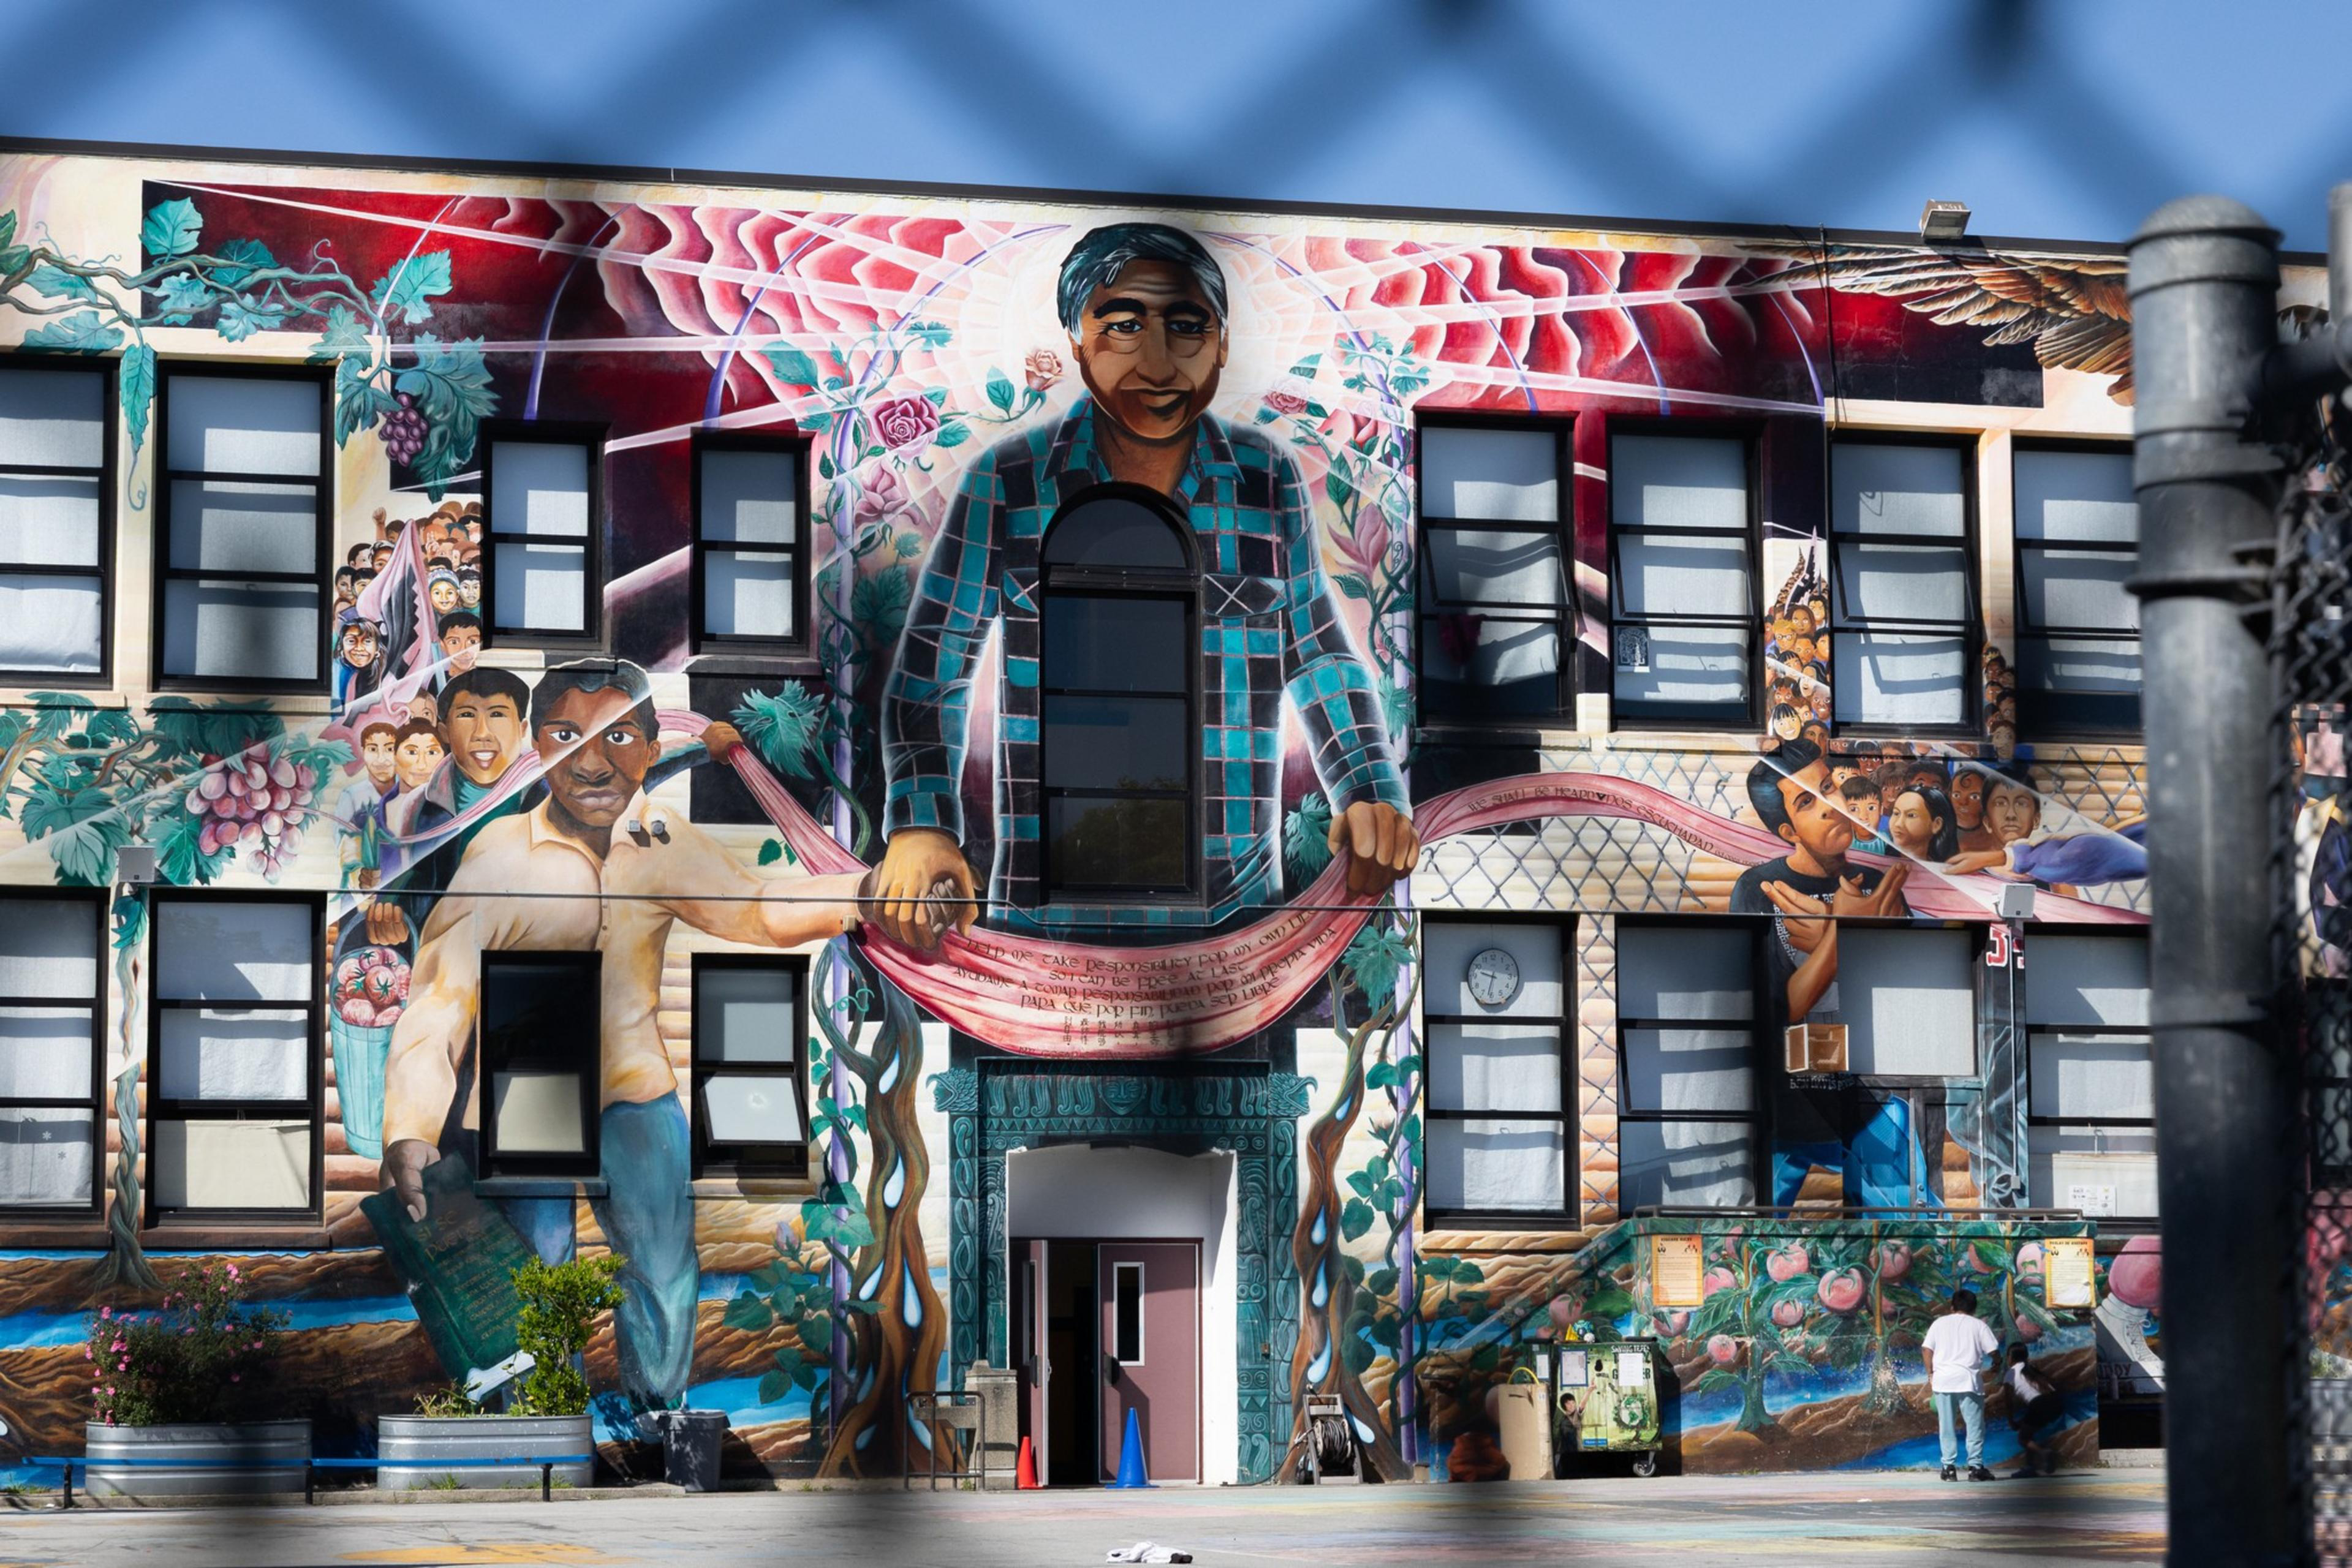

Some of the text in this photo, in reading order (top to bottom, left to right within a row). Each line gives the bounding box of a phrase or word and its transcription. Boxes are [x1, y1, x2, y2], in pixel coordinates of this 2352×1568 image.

[1468, 799, 1487, 812] WE
[1492, 789, 1526, 805] SHALL
[1535, 786, 1550, 797] BE
[967, 939, 1005, 959] HELP
[1012, 949, 1034, 962] ME
[1042, 954, 1080, 968] TAKE
[1086, 957, 1192, 974] RESPONSIBILITY
[1198, 951, 1228, 967] FOR
[1234, 941, 1252, 956] MY
[1259, 925, 1286, 946] OWN
[1019, 980, 1029, 990] A
[1307, 928, 1337, 949] VIDA
[1049, 970, 1066, 980] SO
[1078, 974, 1105, 987] CAN
[1112, 976, 1130, 987] BE
[1138, 974, 1179, 989] FREE
[1186, 971, 1206, 982] AT
[1211, 961, 1248, 978] LAST
[1021, 994, 1056, 1011] PARA
[1242, 977, 1280, 1001] LIBRE
